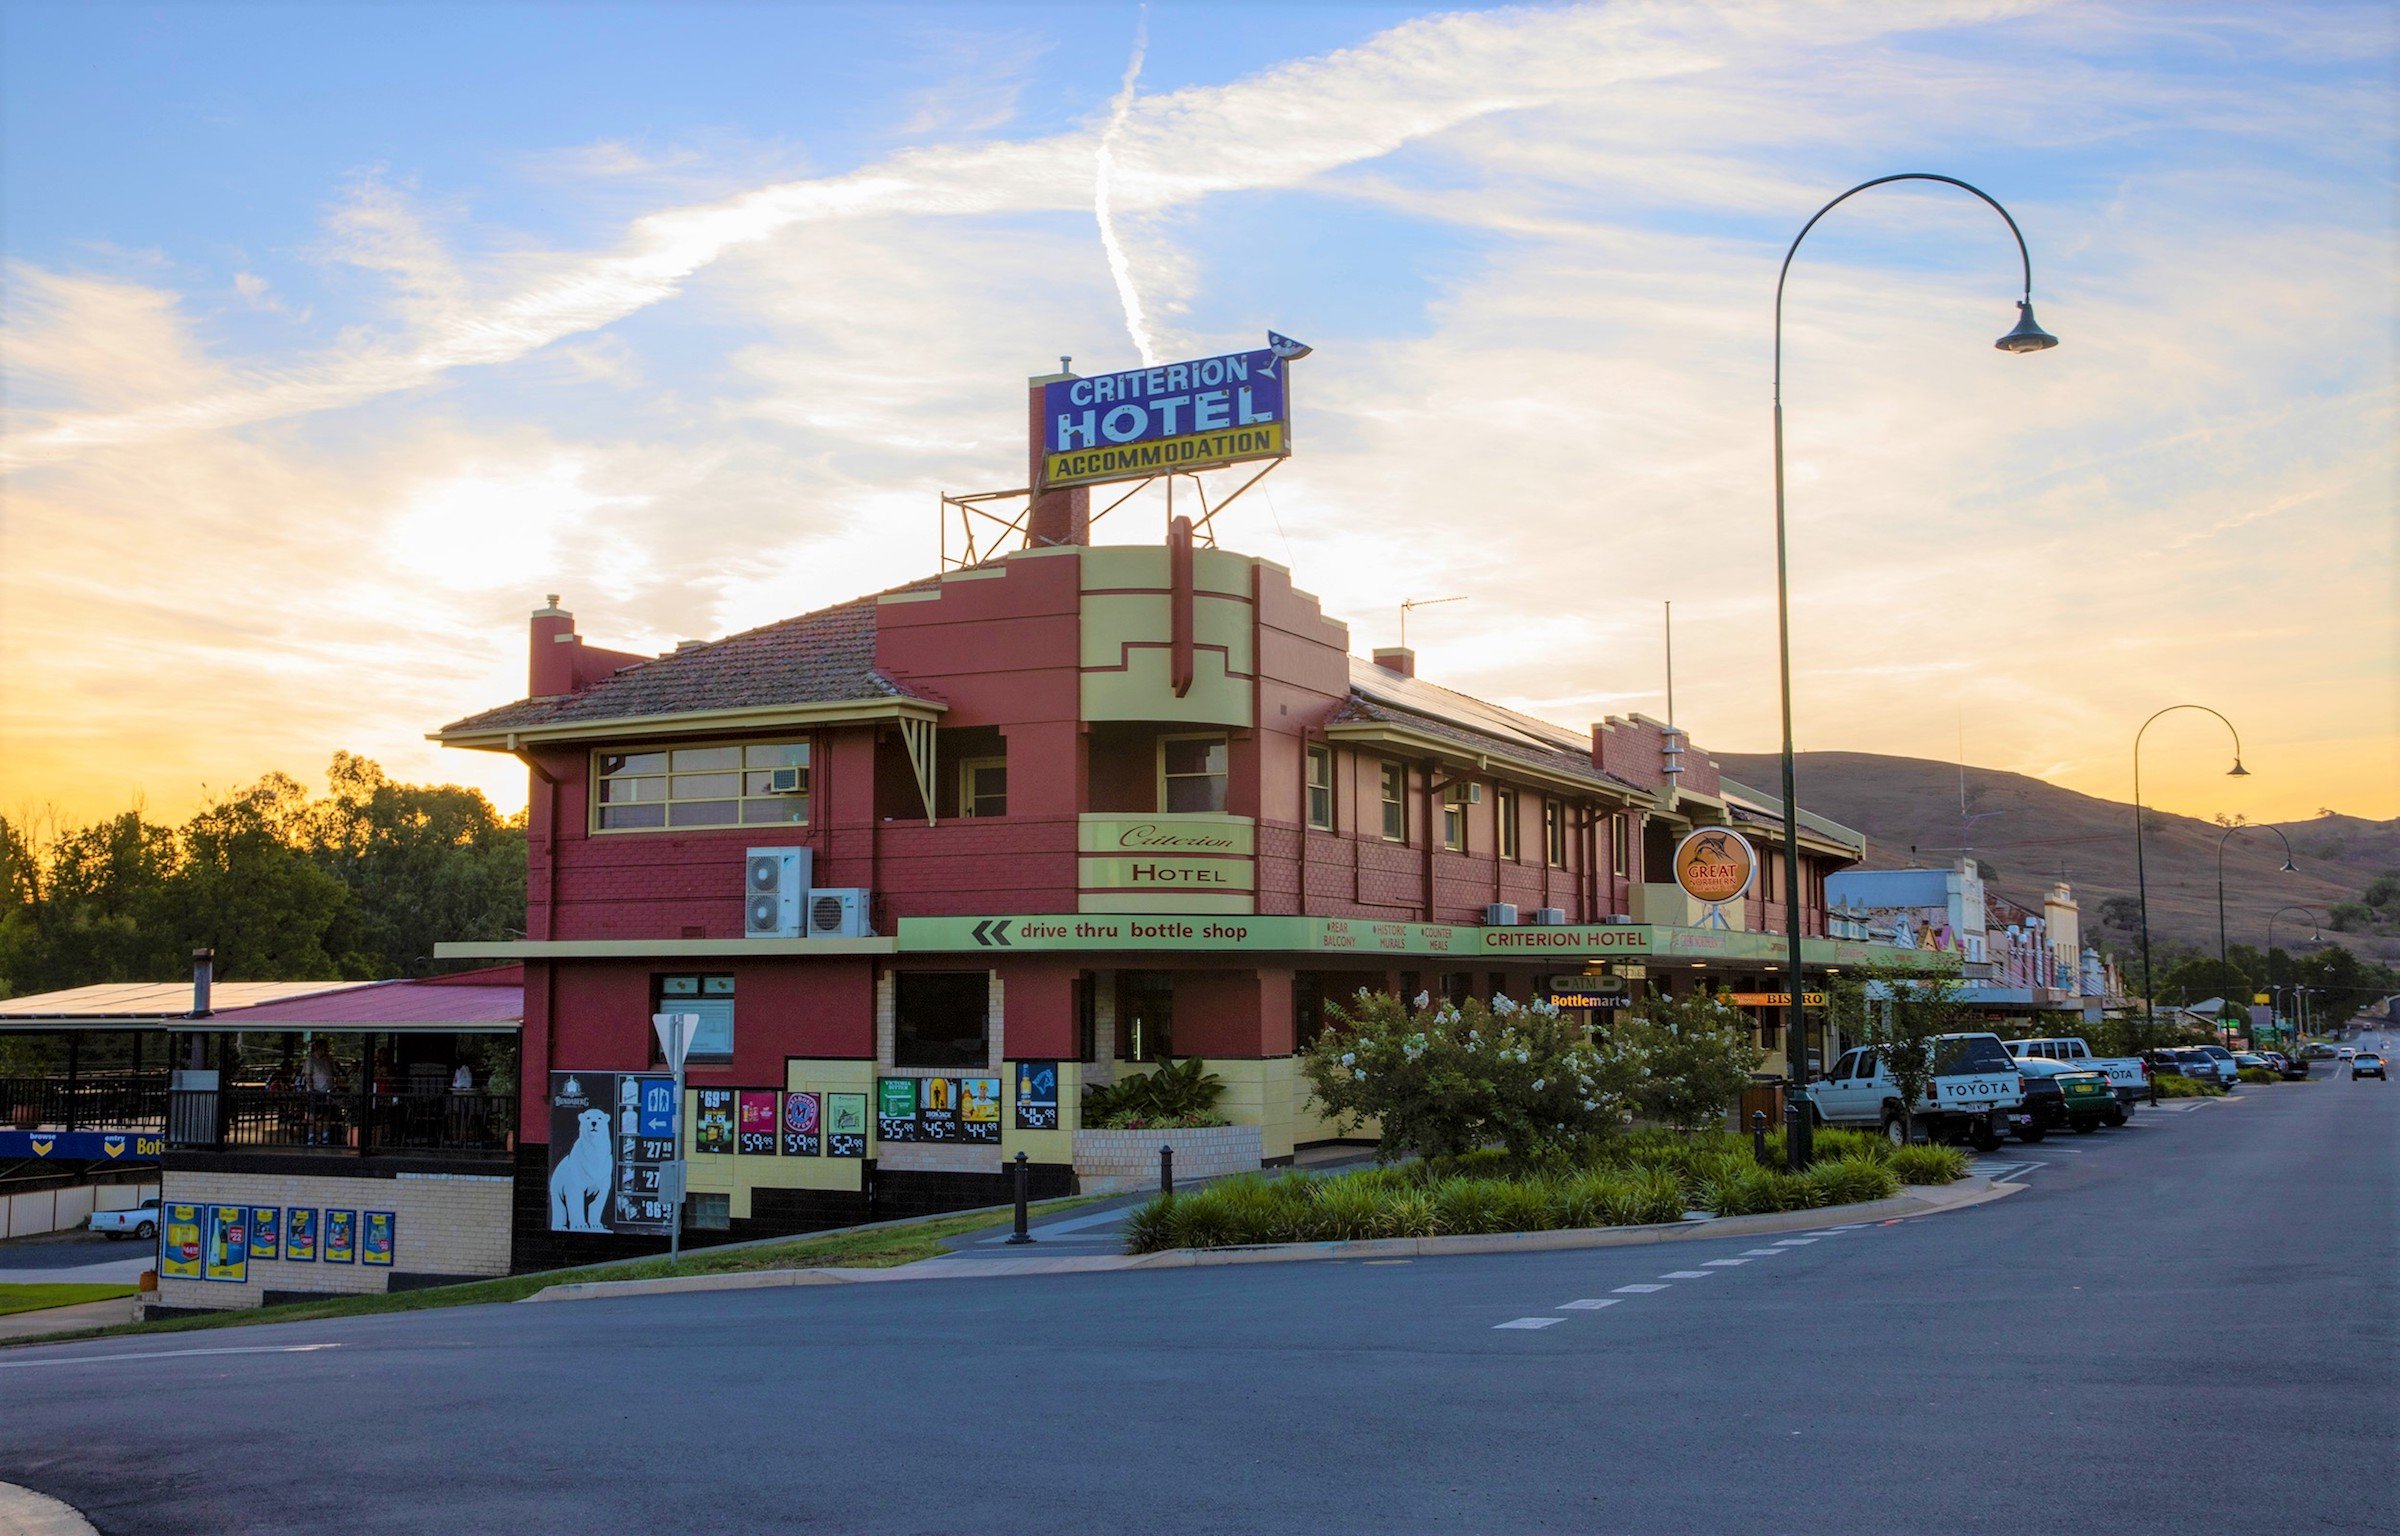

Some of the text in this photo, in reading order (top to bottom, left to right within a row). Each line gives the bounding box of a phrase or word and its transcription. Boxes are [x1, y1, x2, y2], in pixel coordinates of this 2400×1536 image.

[1070, 355, 1248, 406] CRITERION
[1058, 386, 1273, 452] HOTEL
[1056, 430, 1270, 478] ACCOMMODATION
[1119, 824, 1233, 847] Criterion
[1688, 864, 1737, 878] GREAT
[1690, 878, 1736, 886] NORTHERN
[1021, 922, 1247, 941] drive thru bottle shop
[1330, 922, 1348, 933] REAR
[1376, 924, 1407, 936] HISTORIC
[1424, 927, 1452, 939] COUNTER
[1323, 935, 1356, 947] BALCONY
[1380, 938, 1405, 949] MURALS
[1486, 932, 1647, 946] CRITERION HOTEL
[1430, 941, 1448, 951] MEALS
[1571, 977, 1596, 990] ATM
[1551, 993, 1621, 1007] Bottlemart
[1767, 994, 1822, 1004] BISRO
[1946, 1083, 2010, 1096] TOYOTA
[105, 1135, 125, 1143] entry
[136, 1136, 164, 1155] Bot
